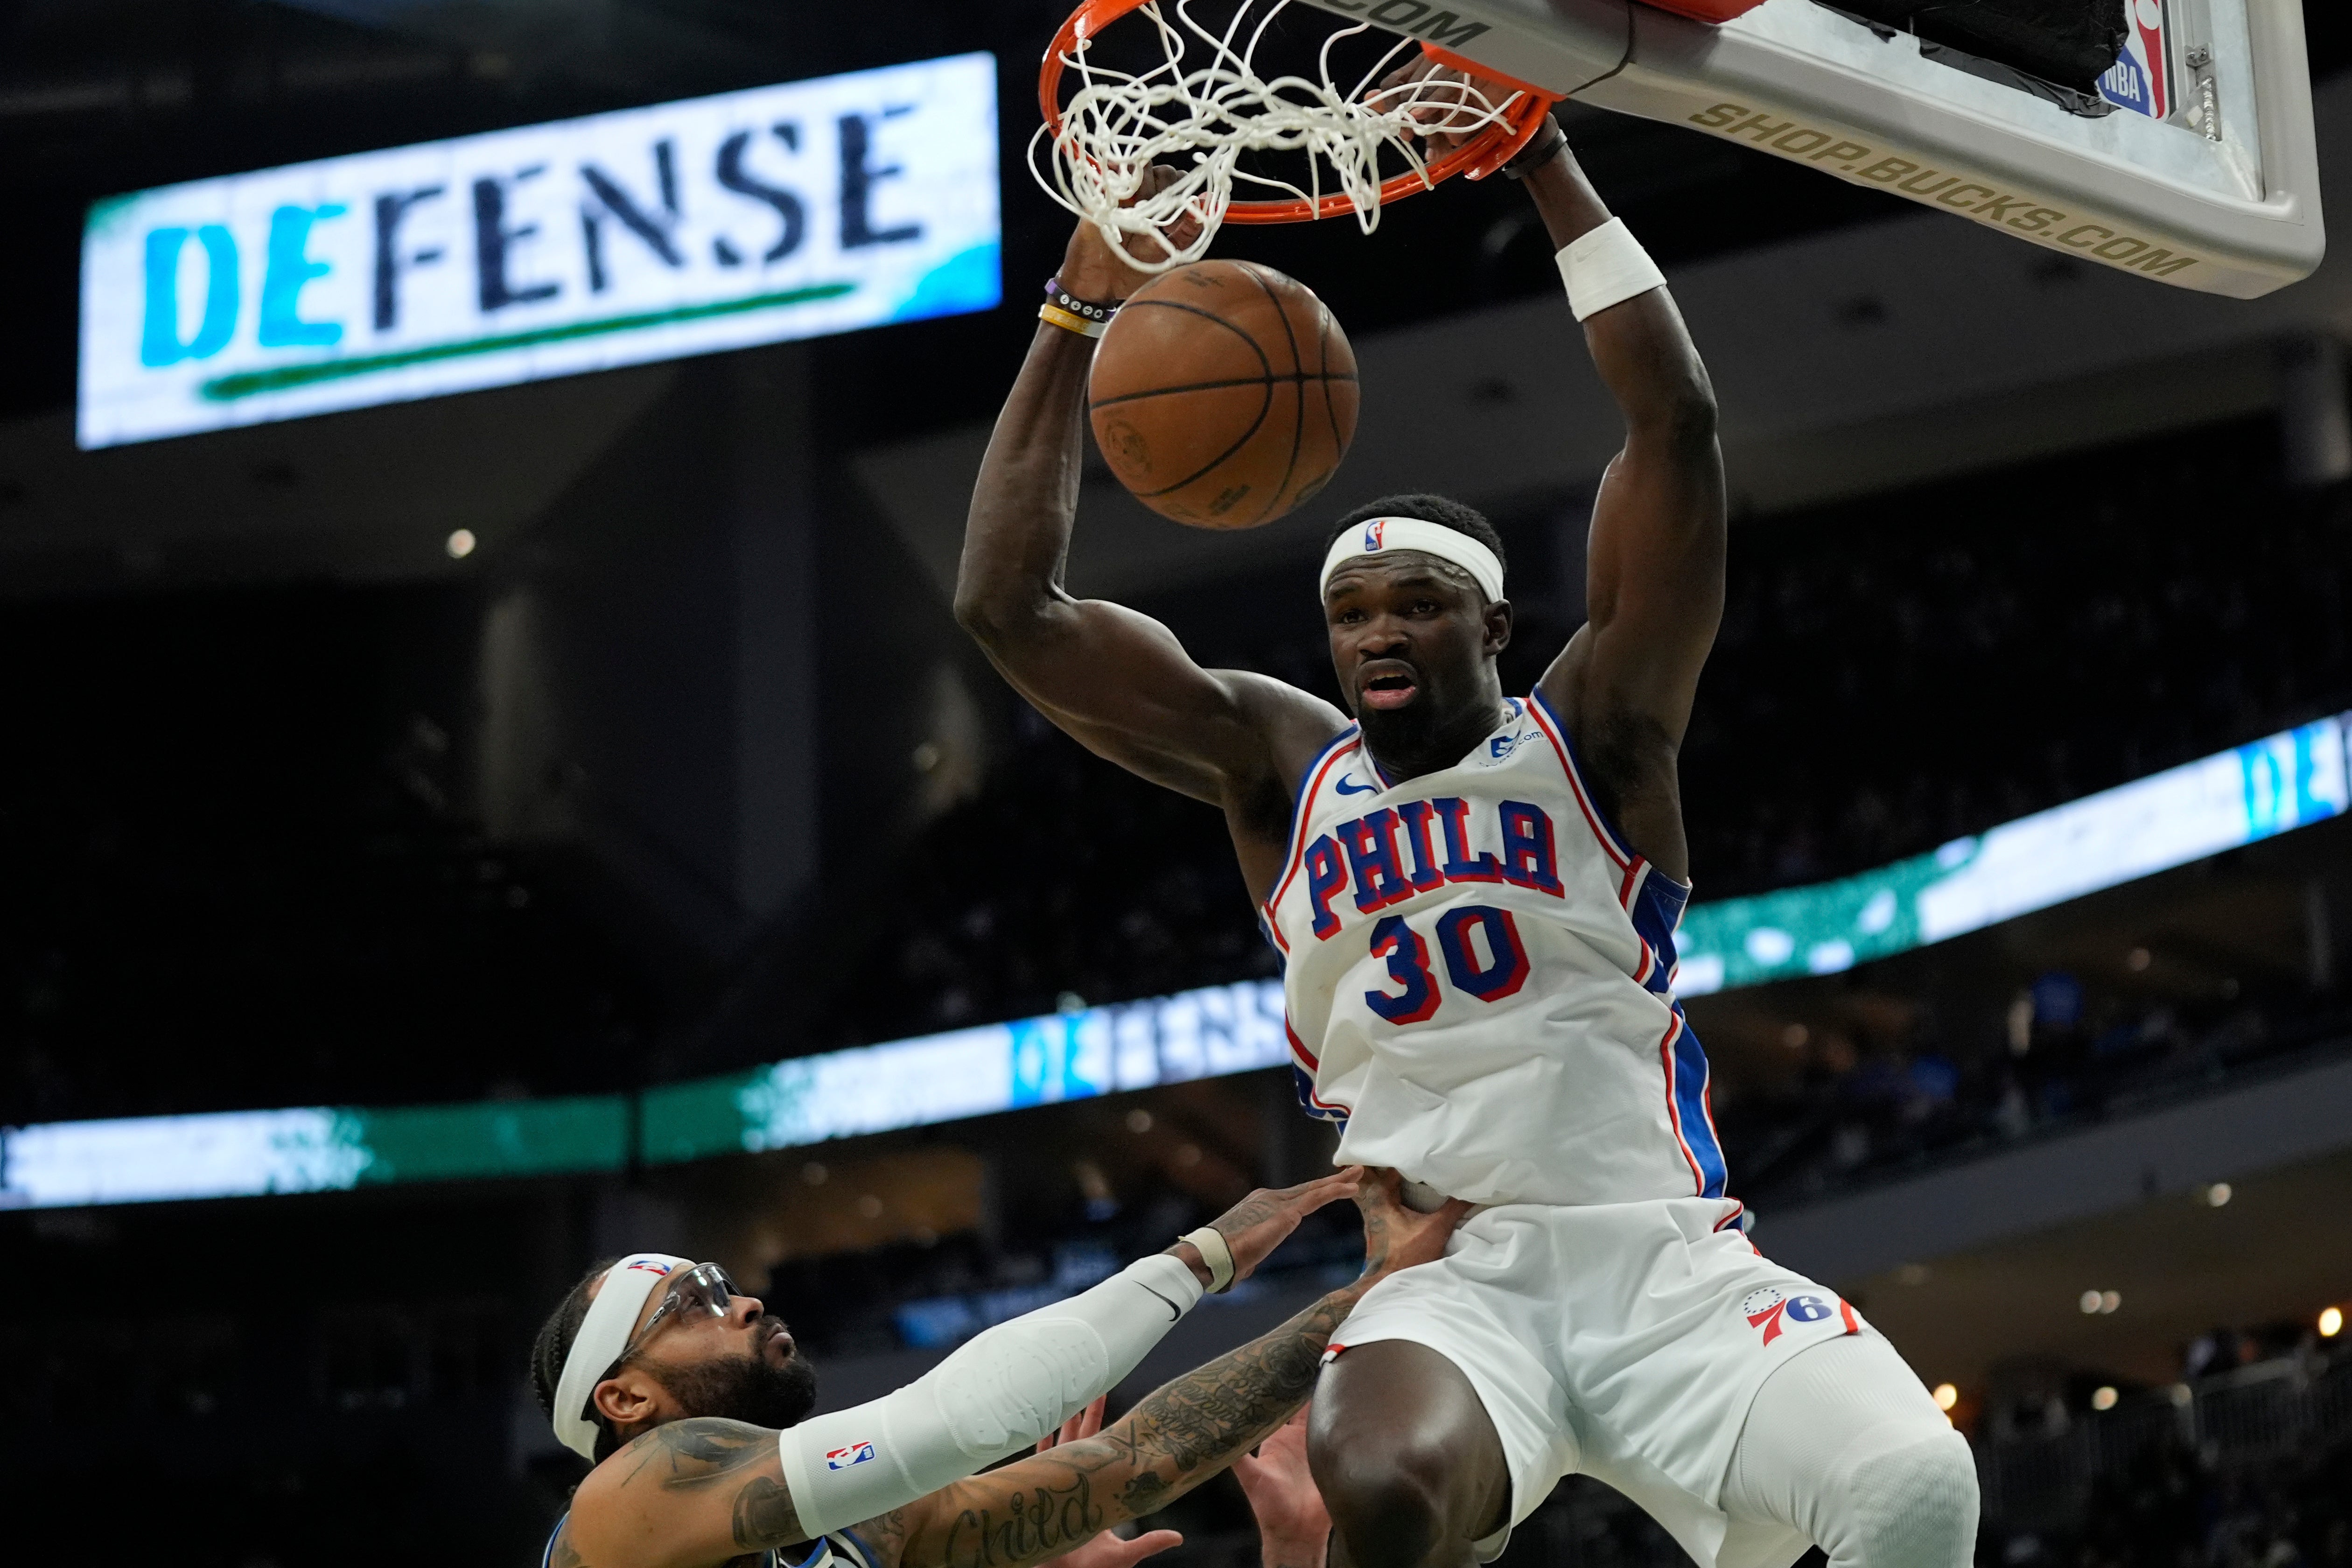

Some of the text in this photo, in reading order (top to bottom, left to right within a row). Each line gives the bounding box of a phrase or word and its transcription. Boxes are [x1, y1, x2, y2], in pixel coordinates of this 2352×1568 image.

[2104, 60, 2141, 102] NBA
[141, 100, 924, 367] DEFENSE
[1688, 102, 2200, 277] SHOP.BUCKS.COM
[1304, 797, 1565, 941] PHILA
[1365, 905, 1531, 1026] 30
[1747, 1295, 1833, 1348] 76
